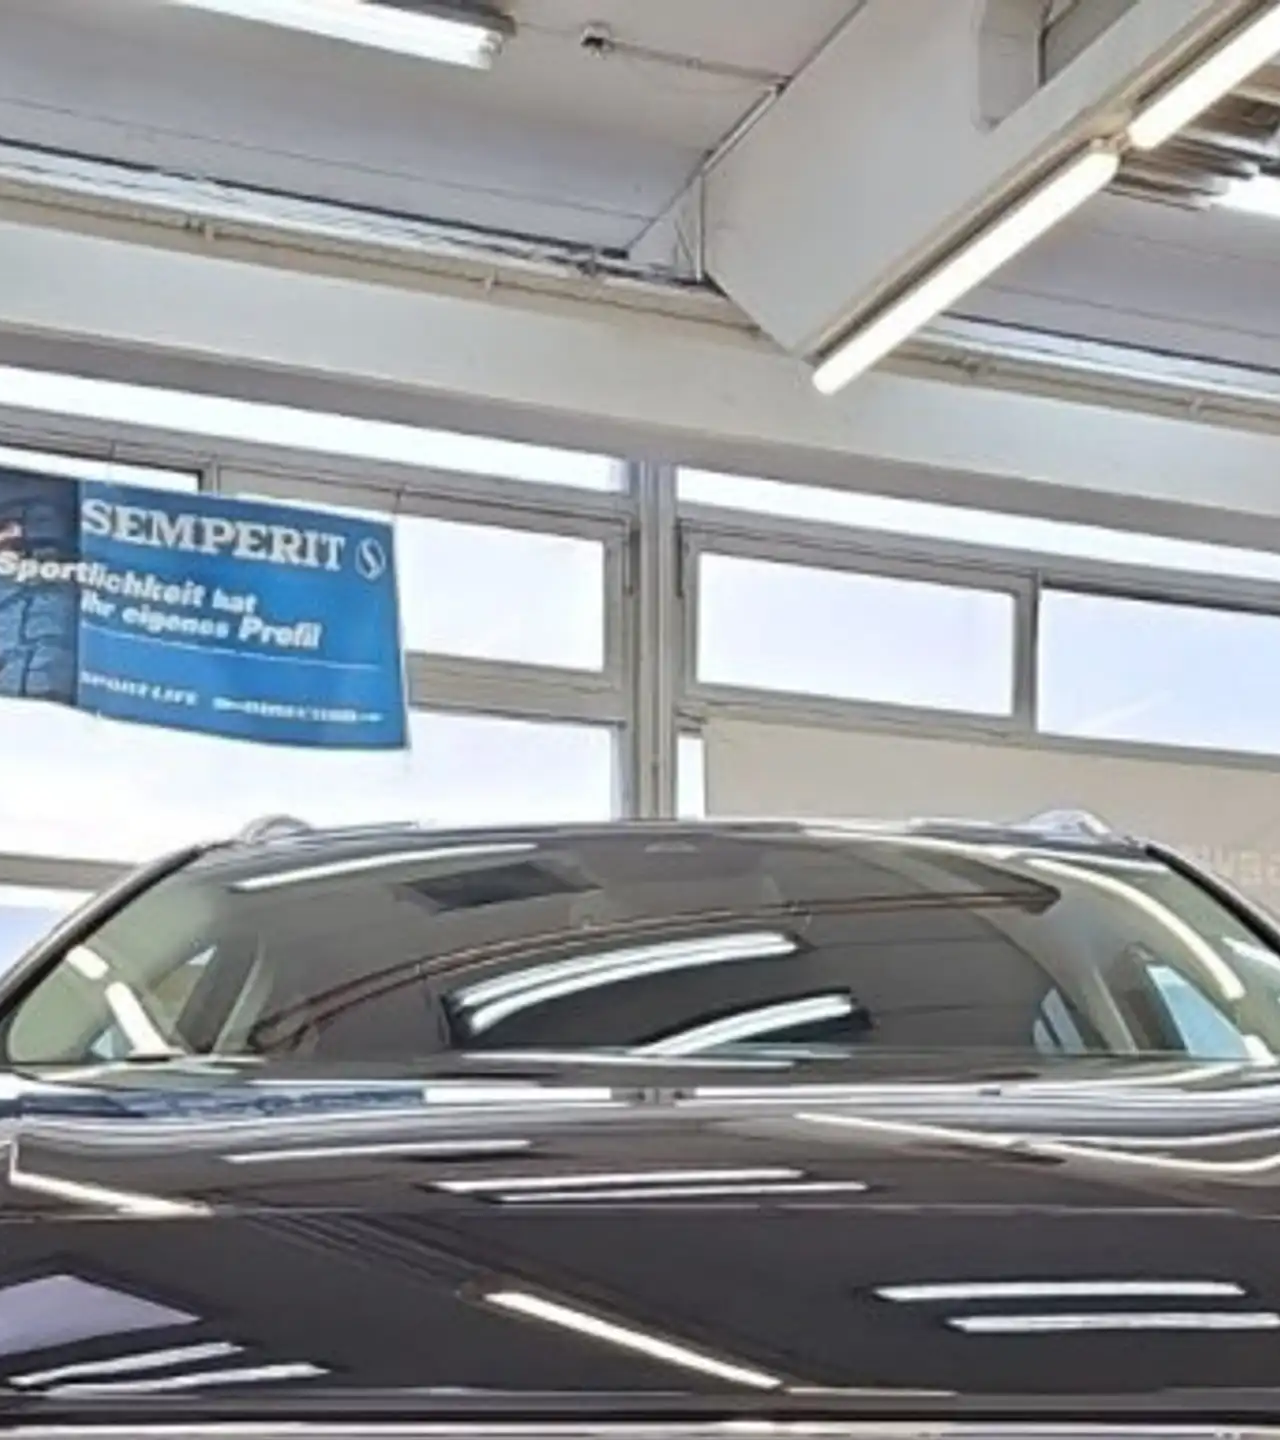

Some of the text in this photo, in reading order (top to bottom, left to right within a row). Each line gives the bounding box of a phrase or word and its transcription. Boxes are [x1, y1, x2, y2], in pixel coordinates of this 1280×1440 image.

[81, 498, 346, 571] SEMPERIT
[212, 587, 257, 614] hat
[122, 604, 229, 639] eigenes
[238, 615, 323, 650] Profil
